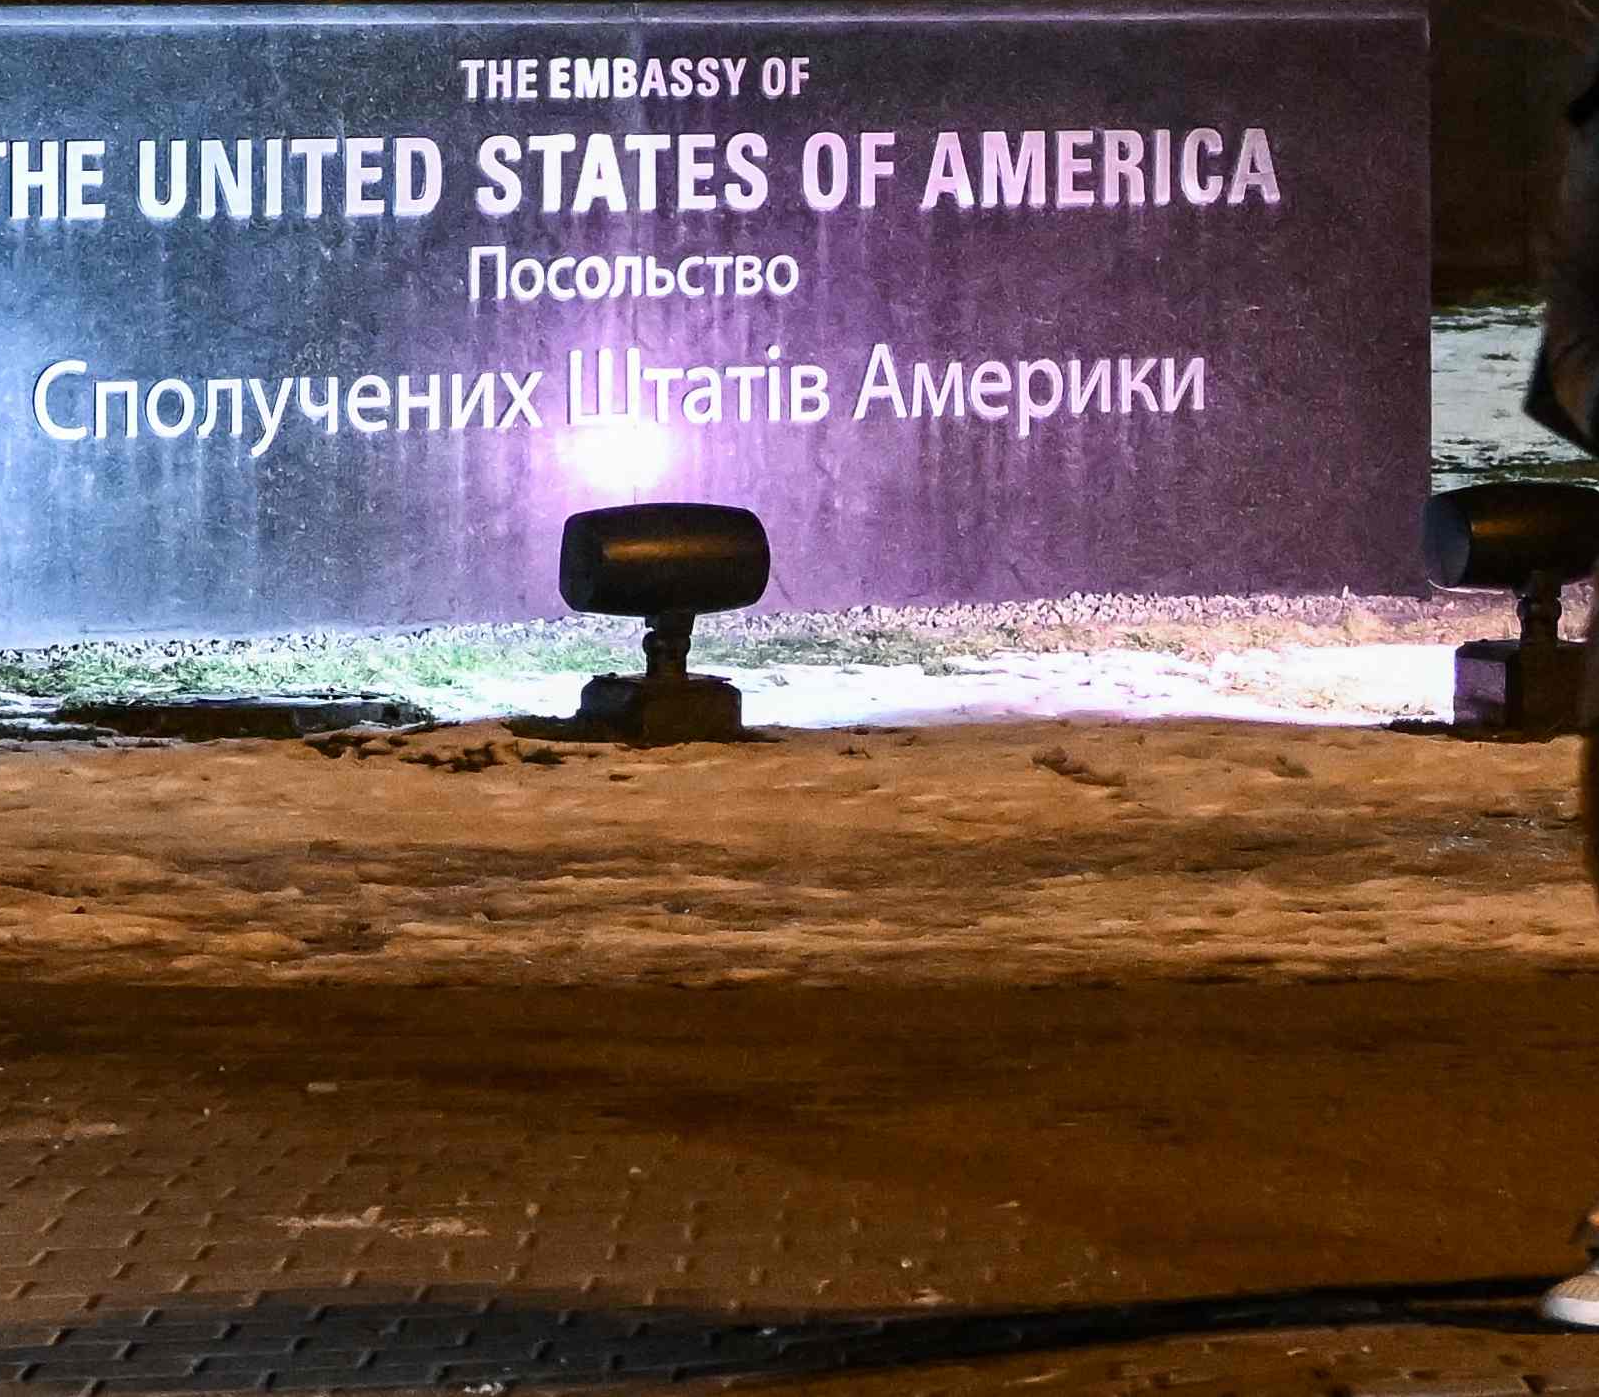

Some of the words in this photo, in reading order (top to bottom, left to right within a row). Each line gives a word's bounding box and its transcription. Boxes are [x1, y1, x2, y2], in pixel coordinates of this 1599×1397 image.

[460, 59, 538, 100] THE
[549, 57, 747, 99] EMBASSY
[762, 57, 810, 98] OF
[137, 136, 442, 221] UNITED
[476, 133, 768, 215] STATES
[802, 132, 894, 212] OF
[920, 128, 1281, 210] AMERICA
[469, 246, 799, 301] Посольство
[35, 360, 542, 457] Сполучених
[569, 344, 830, 427] Штатів
[852, 344, 1205, 438] Америки
